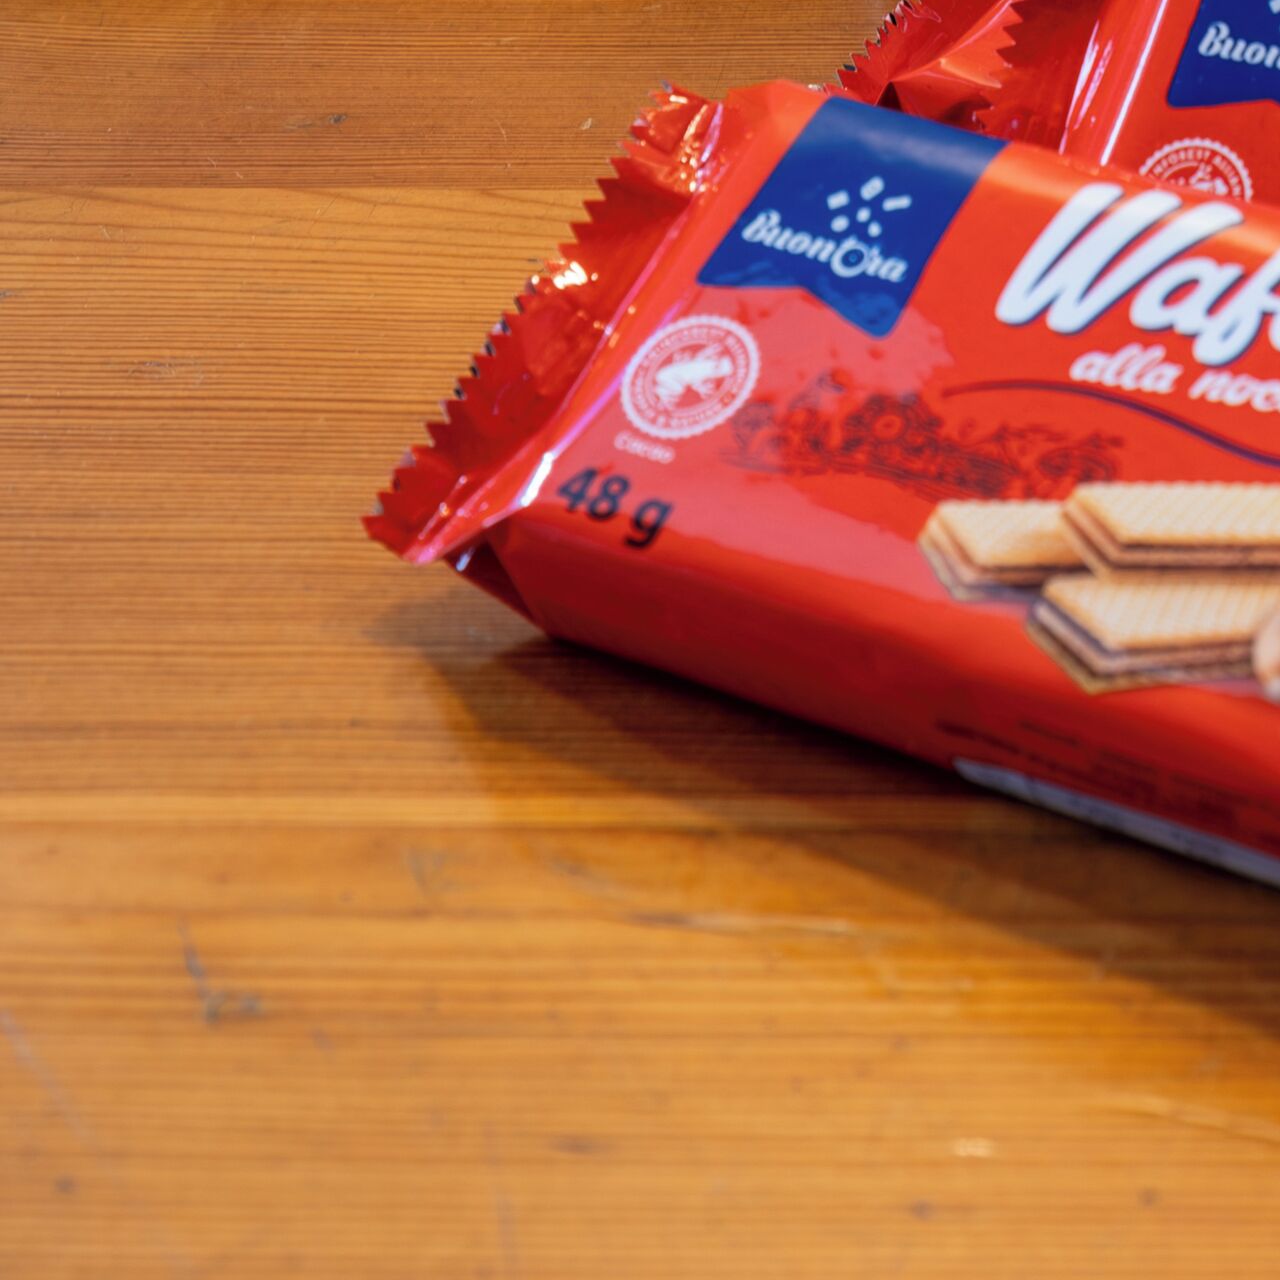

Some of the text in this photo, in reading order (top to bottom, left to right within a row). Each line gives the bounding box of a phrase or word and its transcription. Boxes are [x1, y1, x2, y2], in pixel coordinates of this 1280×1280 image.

[1069, 343, 1184, 395] alla
[556, 466, 674, 549] 48 g
